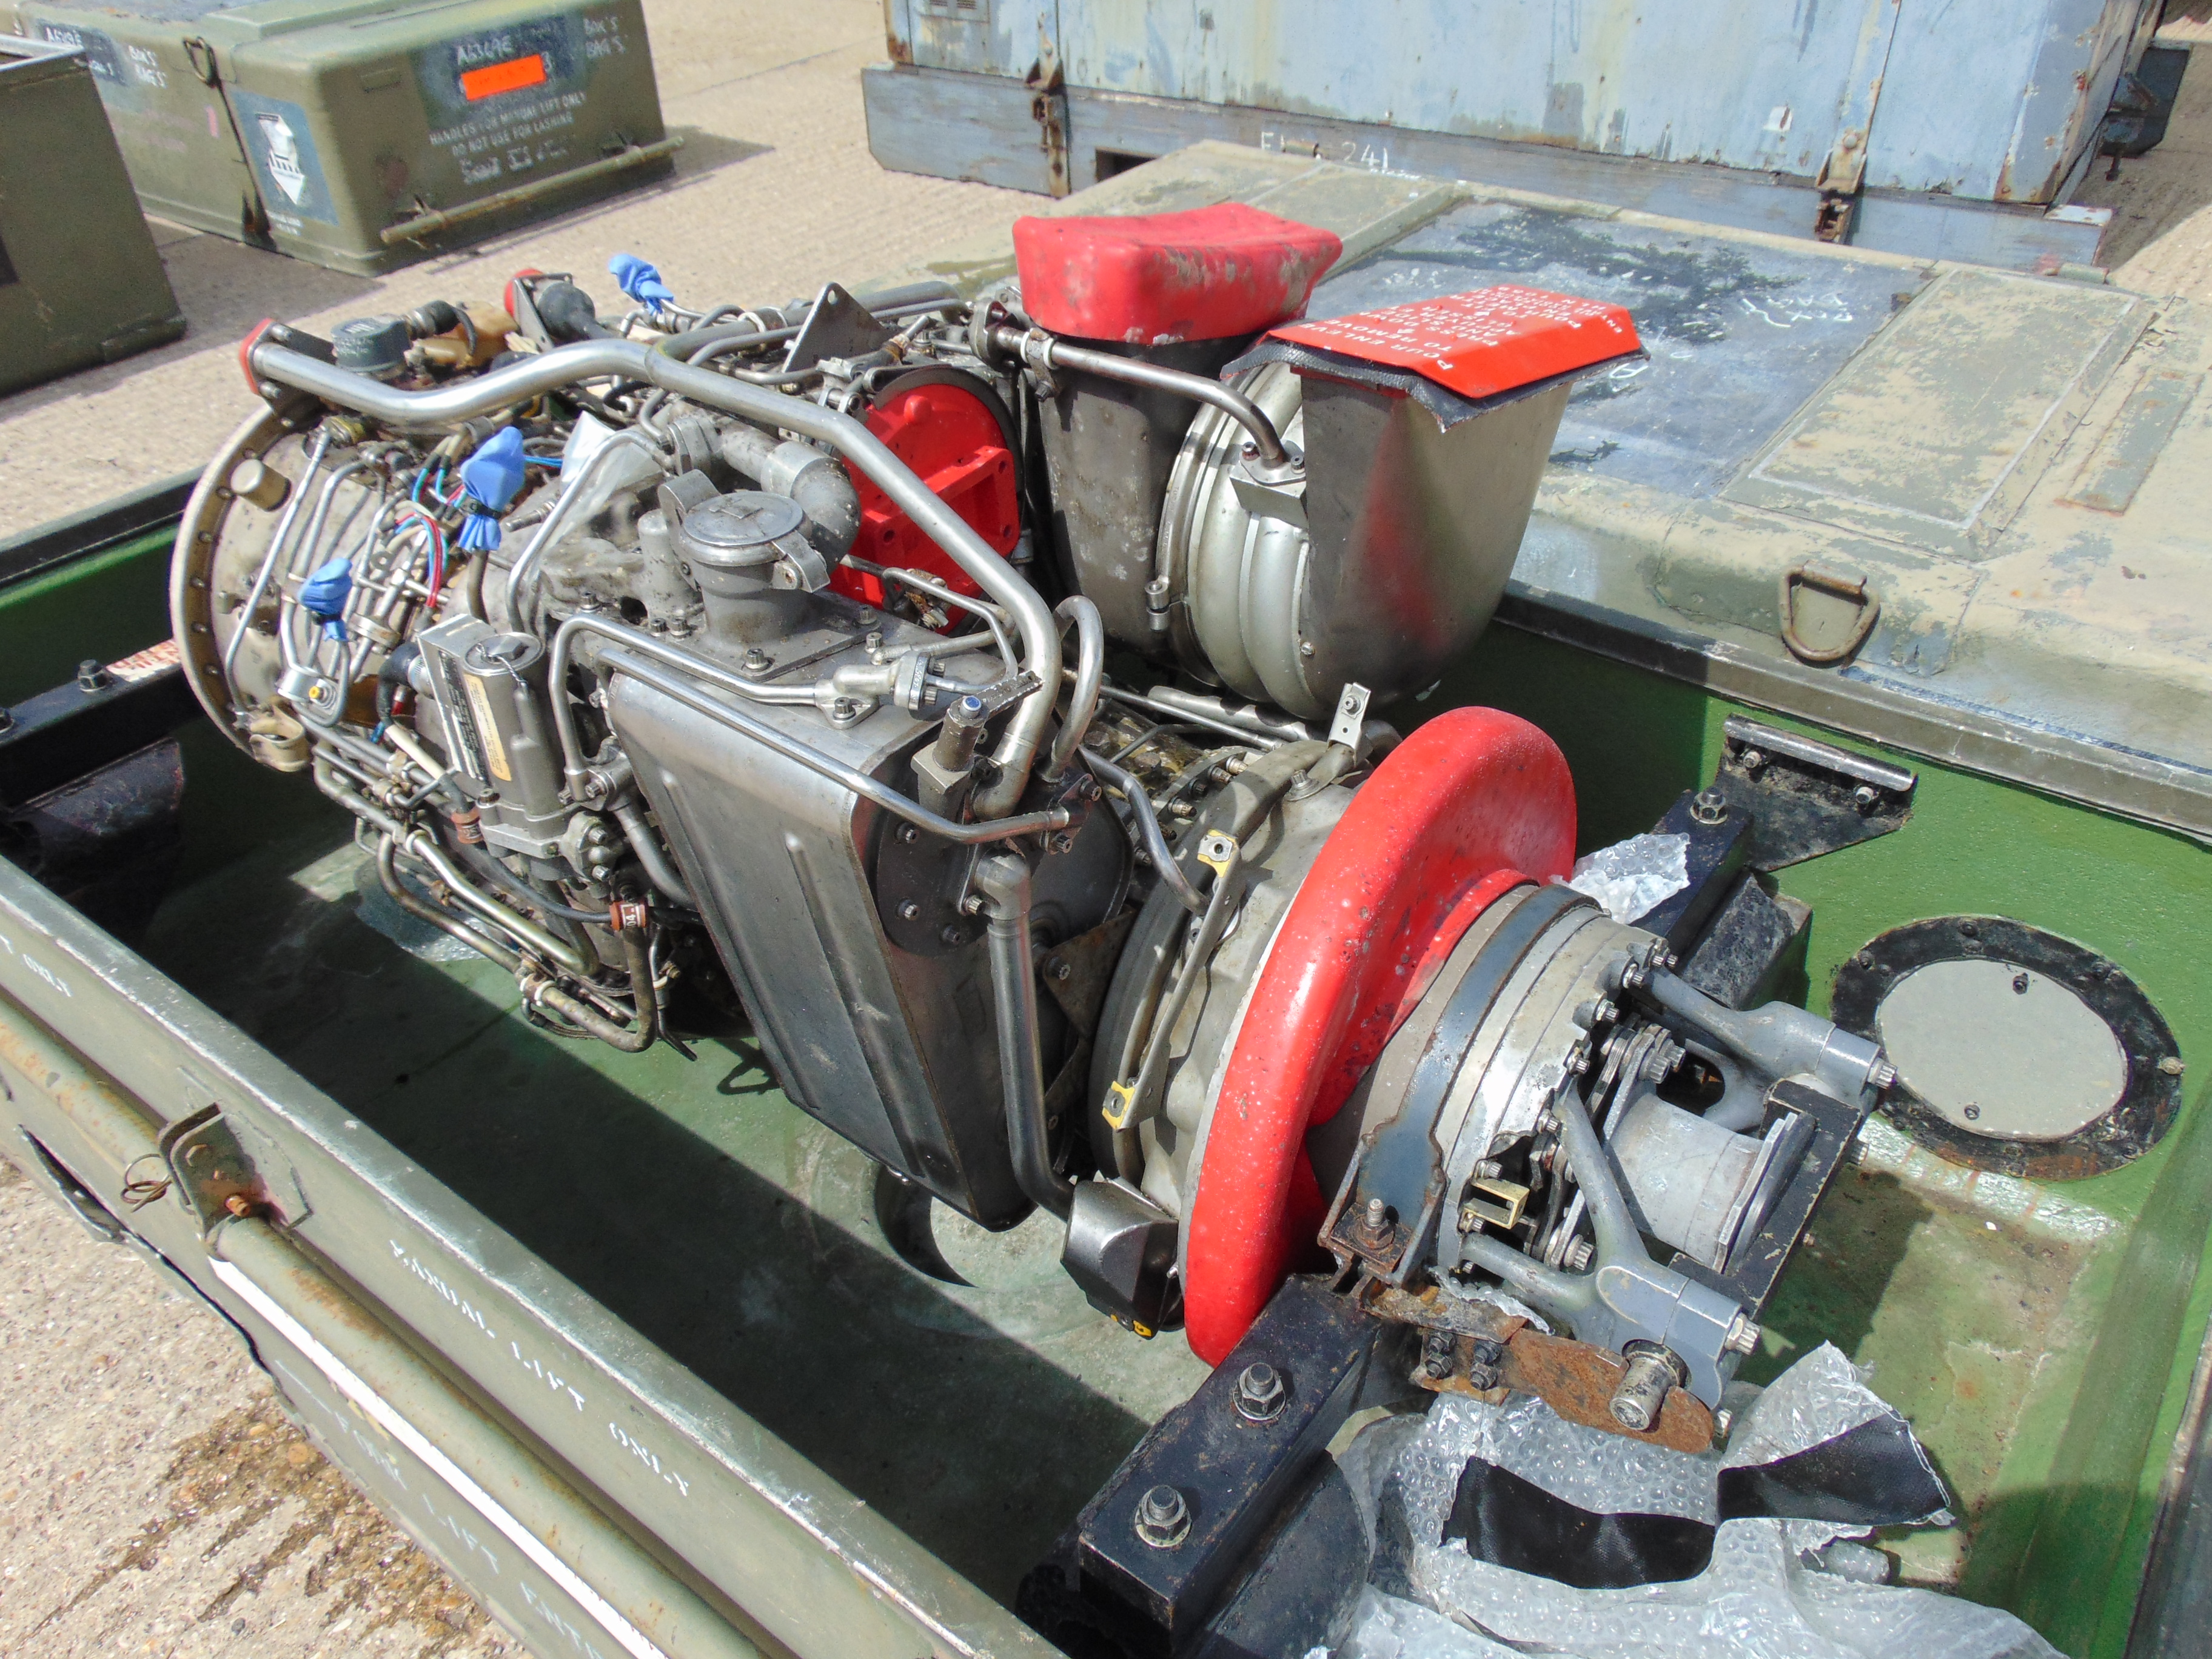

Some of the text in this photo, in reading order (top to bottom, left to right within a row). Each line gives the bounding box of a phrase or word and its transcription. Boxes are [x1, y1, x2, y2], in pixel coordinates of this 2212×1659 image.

[1324, 320, 1452, 352] TO REMOVE
[1390, 344, 1453, 370] POUR
[511, 1341, 585, 1412] LIFT
[608, 1422, 689, 1497] ONLY
